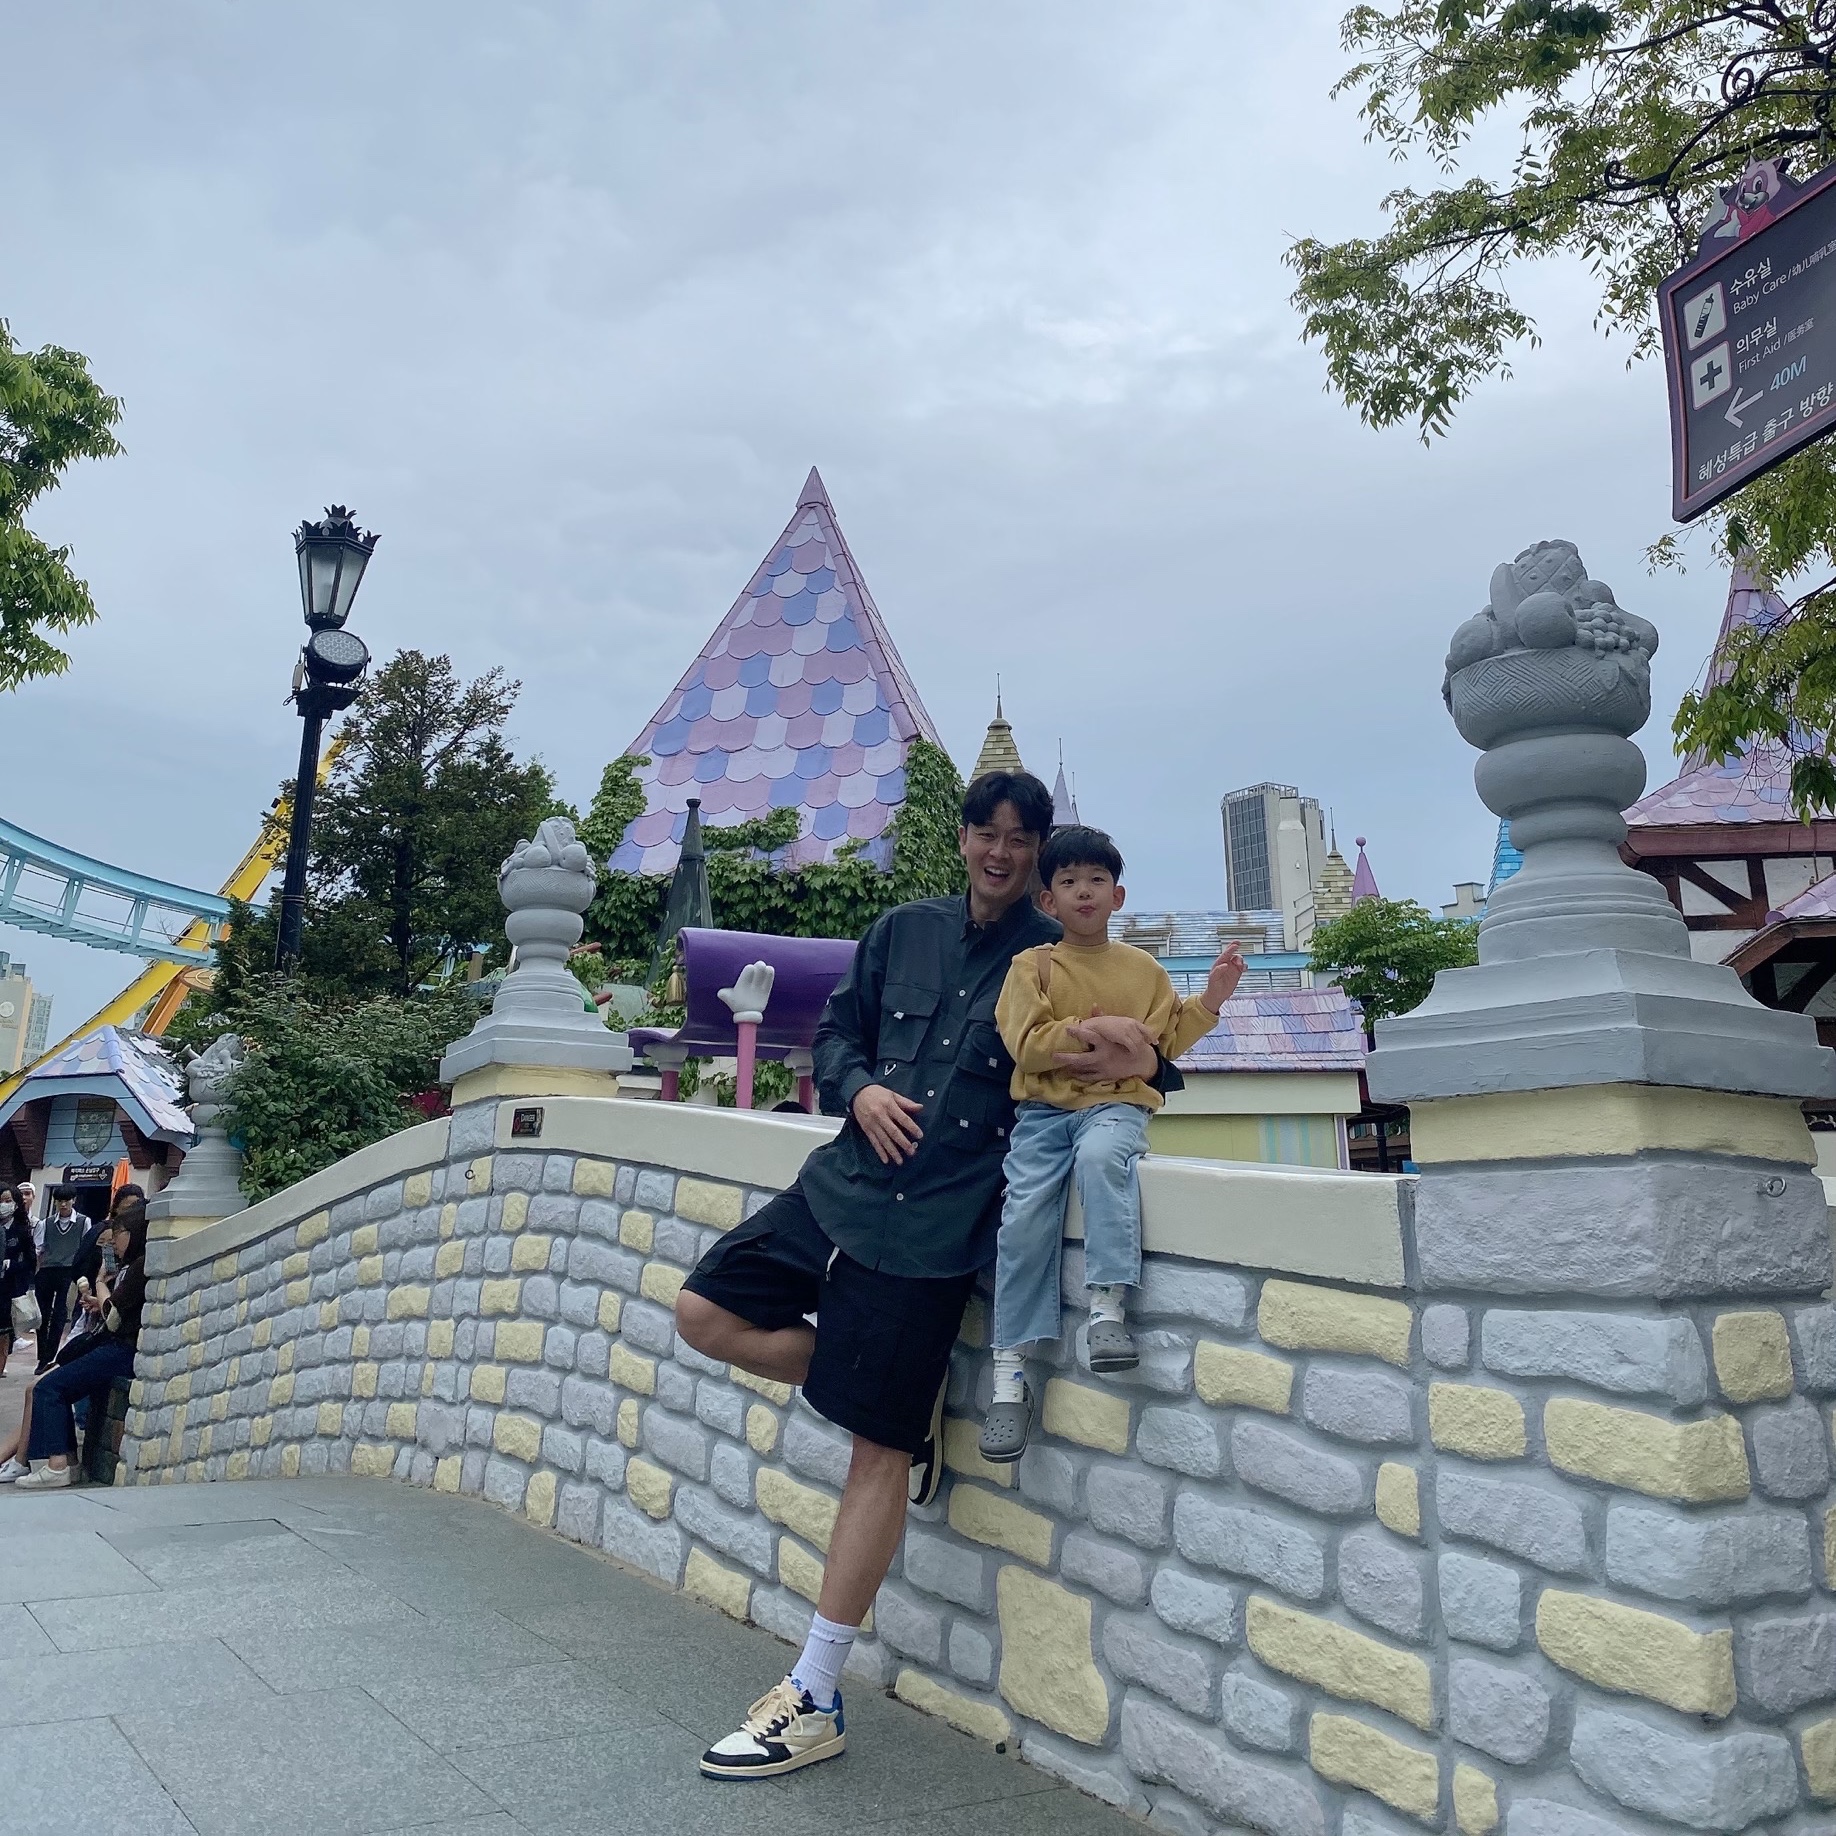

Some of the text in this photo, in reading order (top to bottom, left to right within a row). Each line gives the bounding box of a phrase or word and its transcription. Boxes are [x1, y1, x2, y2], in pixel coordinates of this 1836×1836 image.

[1730, 257, 1772, 295] 수유실
[1733, 292, 1760, 315] Baby
[1736, 316, 1777, 354] 의무실
[1739, 352, 1761, 373] First
[1762, 337, 1781, 359] Aid
[1770, 355, 1807, 391] 40M
[1698, 381, 1834, 481] 혜성특급 출구 방향
